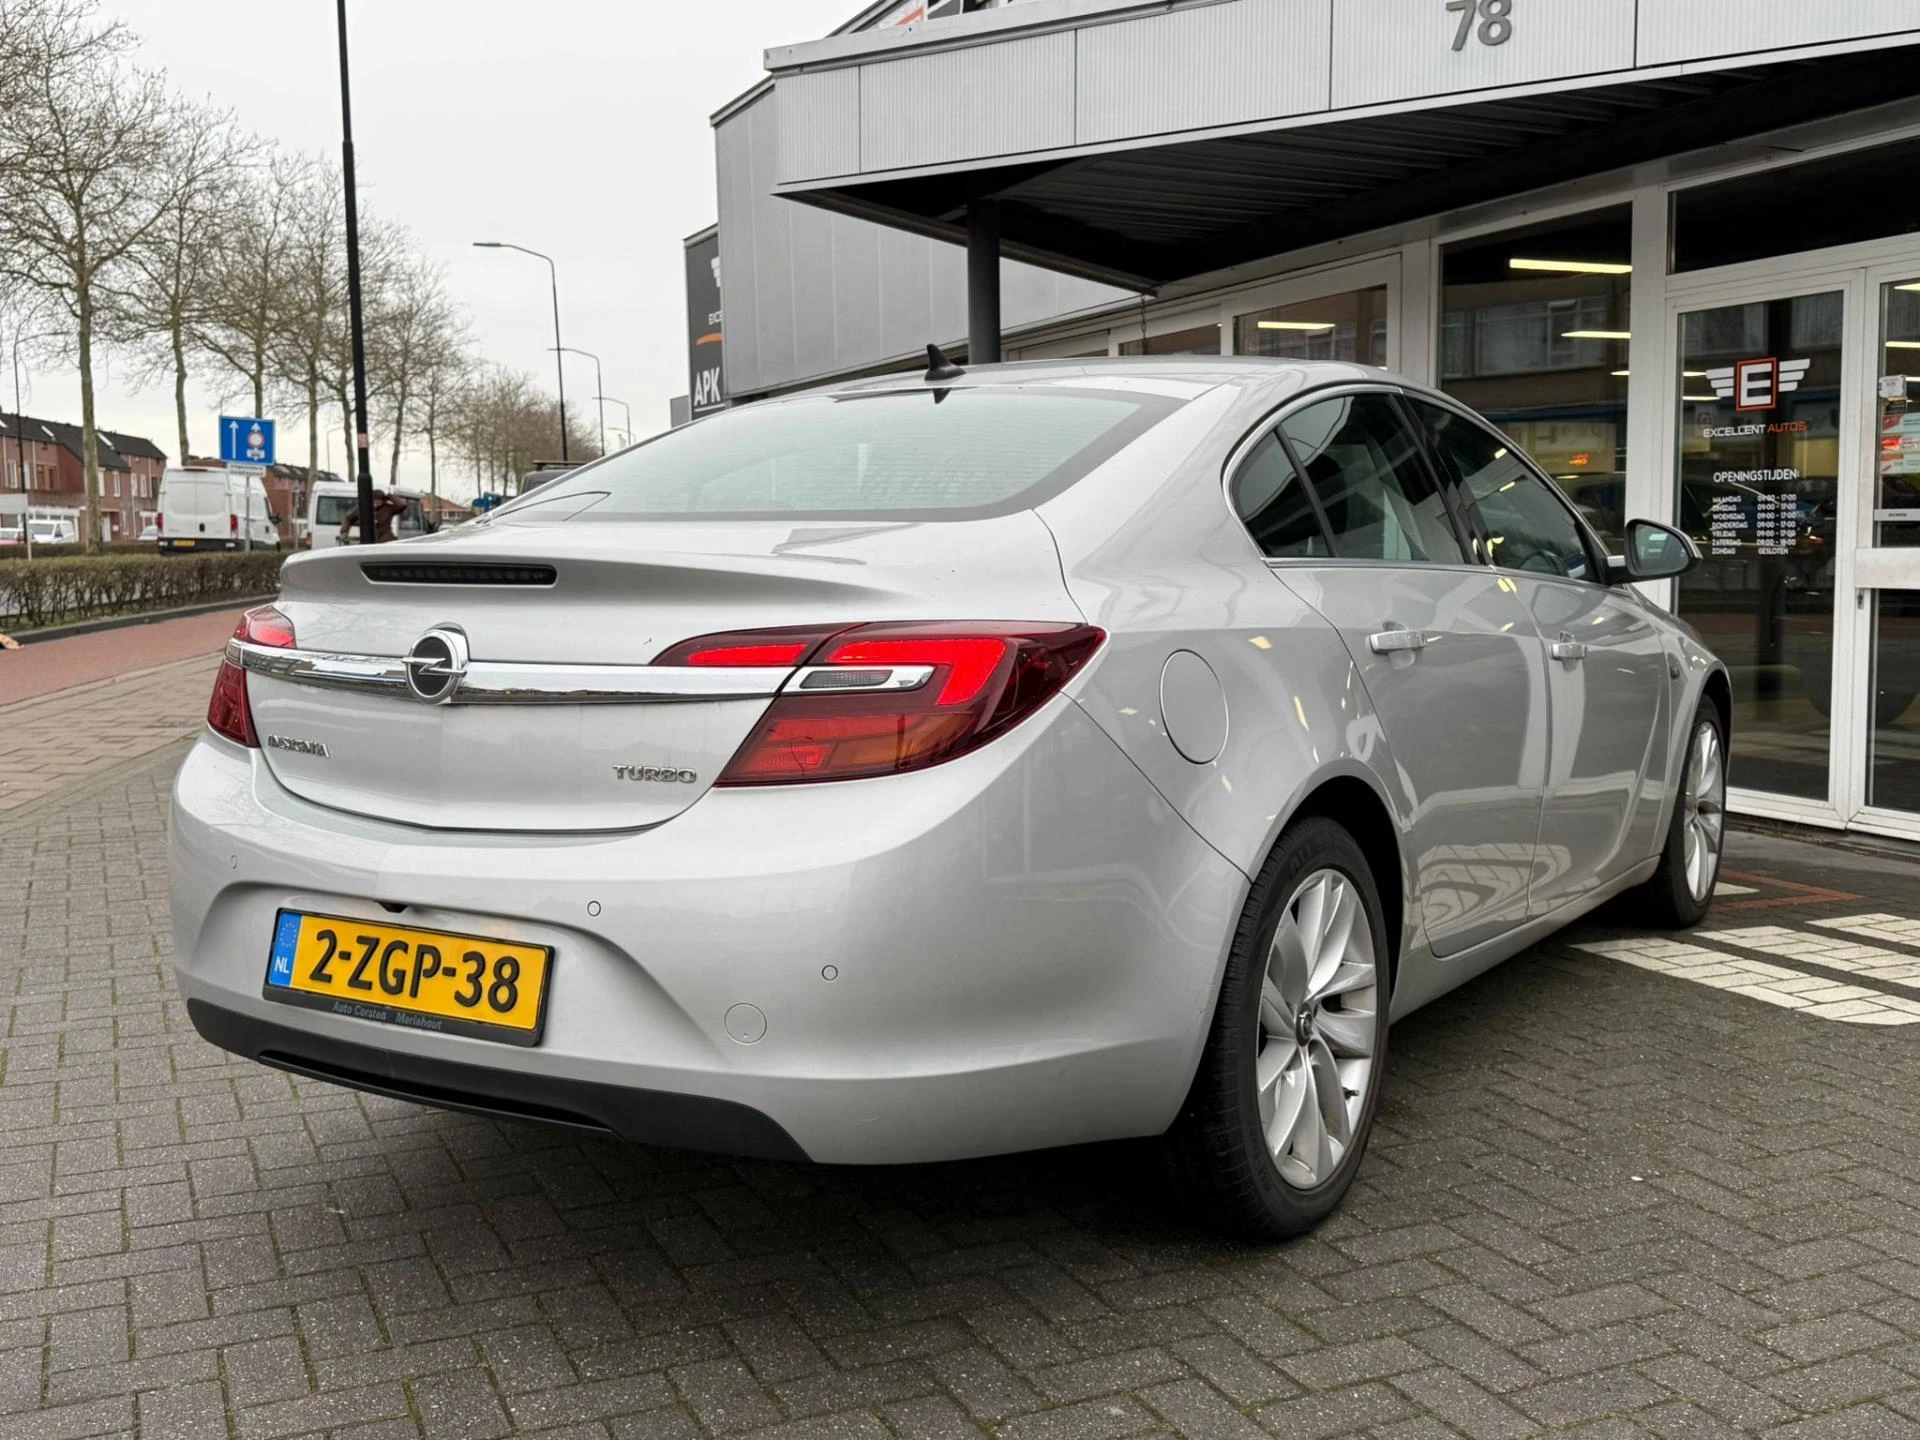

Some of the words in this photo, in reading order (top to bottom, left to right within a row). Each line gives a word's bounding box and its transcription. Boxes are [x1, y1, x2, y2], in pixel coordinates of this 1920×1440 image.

[1446, 0, 1512, 51] 78
[693, 367, 721, 406] APK
[1740, 362, 1773, 407] E
[1703, 424, 1766, 438] EXCELLENT
[1767, 421, 1807, 433] AUTOS
[1713, 468, 1800, 483] OPENINGSTIJDEN:
[612, 765, 697, 784] TURBO
[274, 959, 290, 974] NL
[308, 929, 521, 1013] 2-ZGP-38
[332, 1001, 352, 1016] Auto
[354, 1004, 387, 1021] Corsten
[395, 1011, 442, 1031] Mariahout
